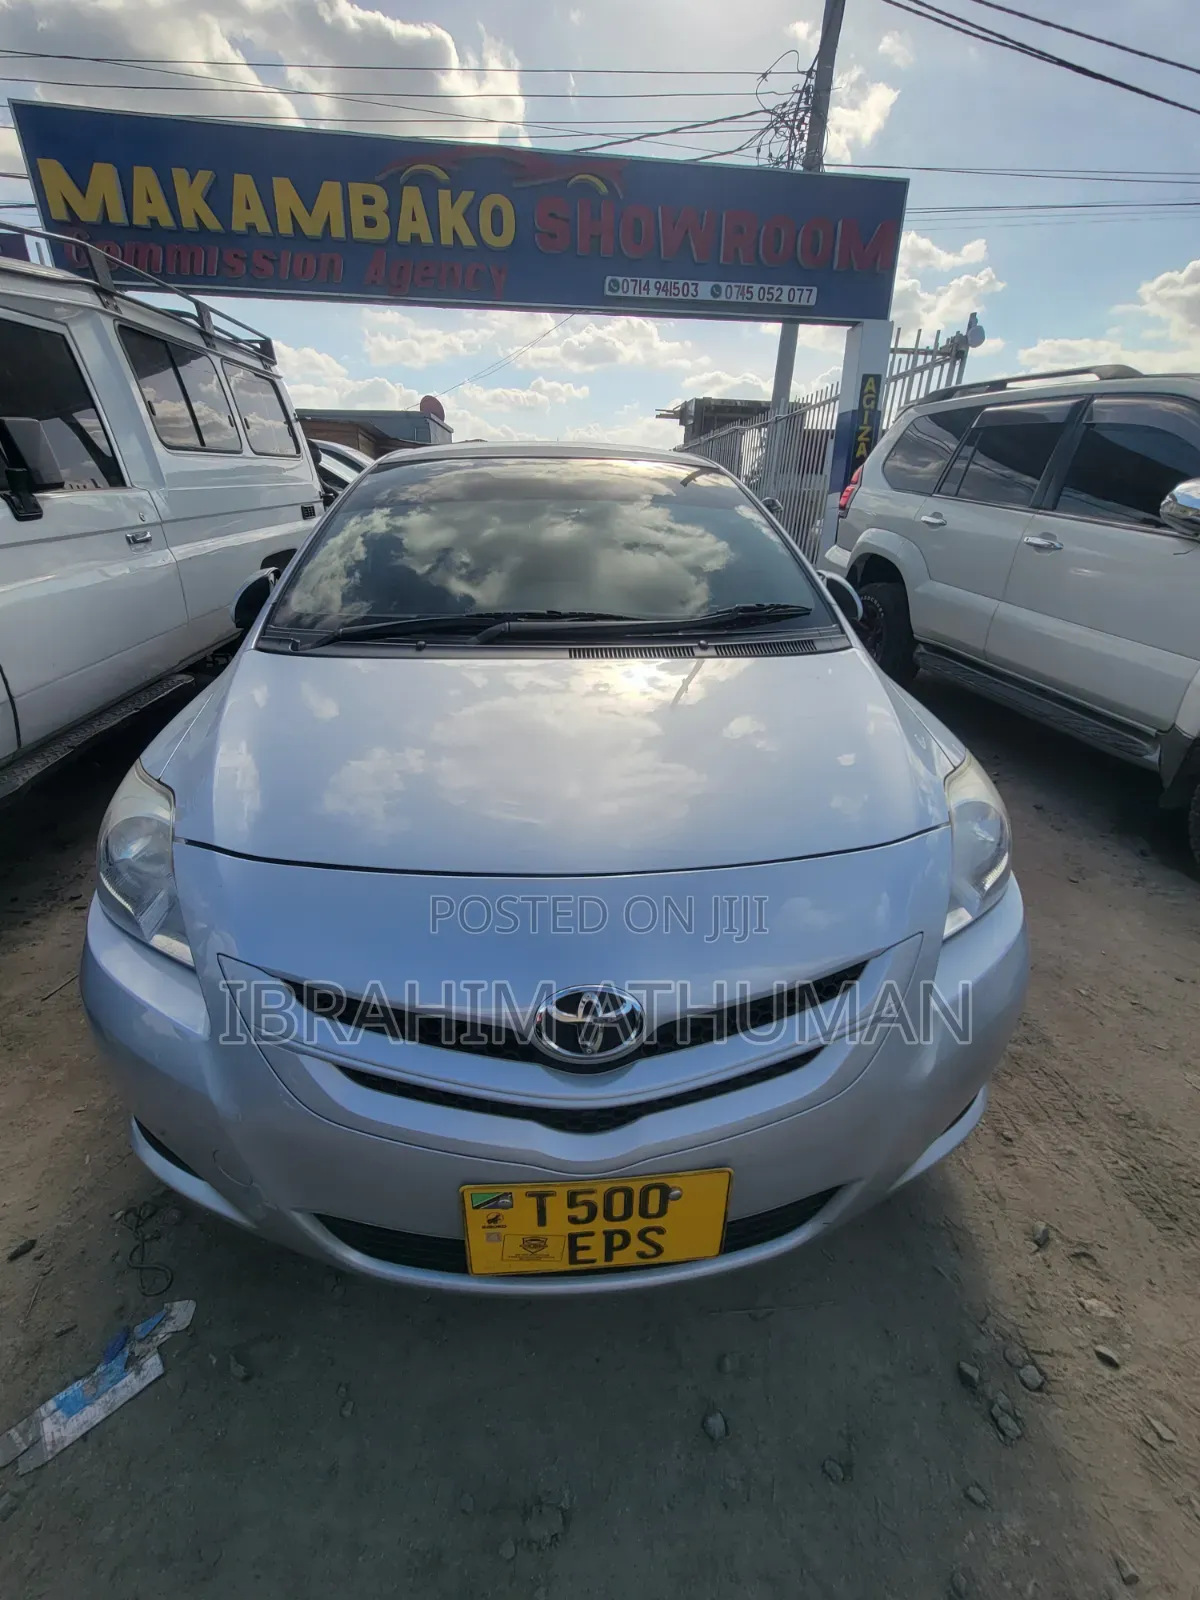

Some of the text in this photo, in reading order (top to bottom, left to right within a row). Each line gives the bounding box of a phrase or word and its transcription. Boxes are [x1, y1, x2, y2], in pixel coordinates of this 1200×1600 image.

[37, 158, 898, 272] MAKAMBAKO SHOWROOM
[364, 248, 508, 300] Agency
[622, 278, 699, 298] 0714 941503
[725, 285, 813, 303] 0745 052 077
[856, 377, 877, 458] AGIZA
[525, 1182, 670, 1227] T 500
[568, 1225, 667, 1265] EPS
